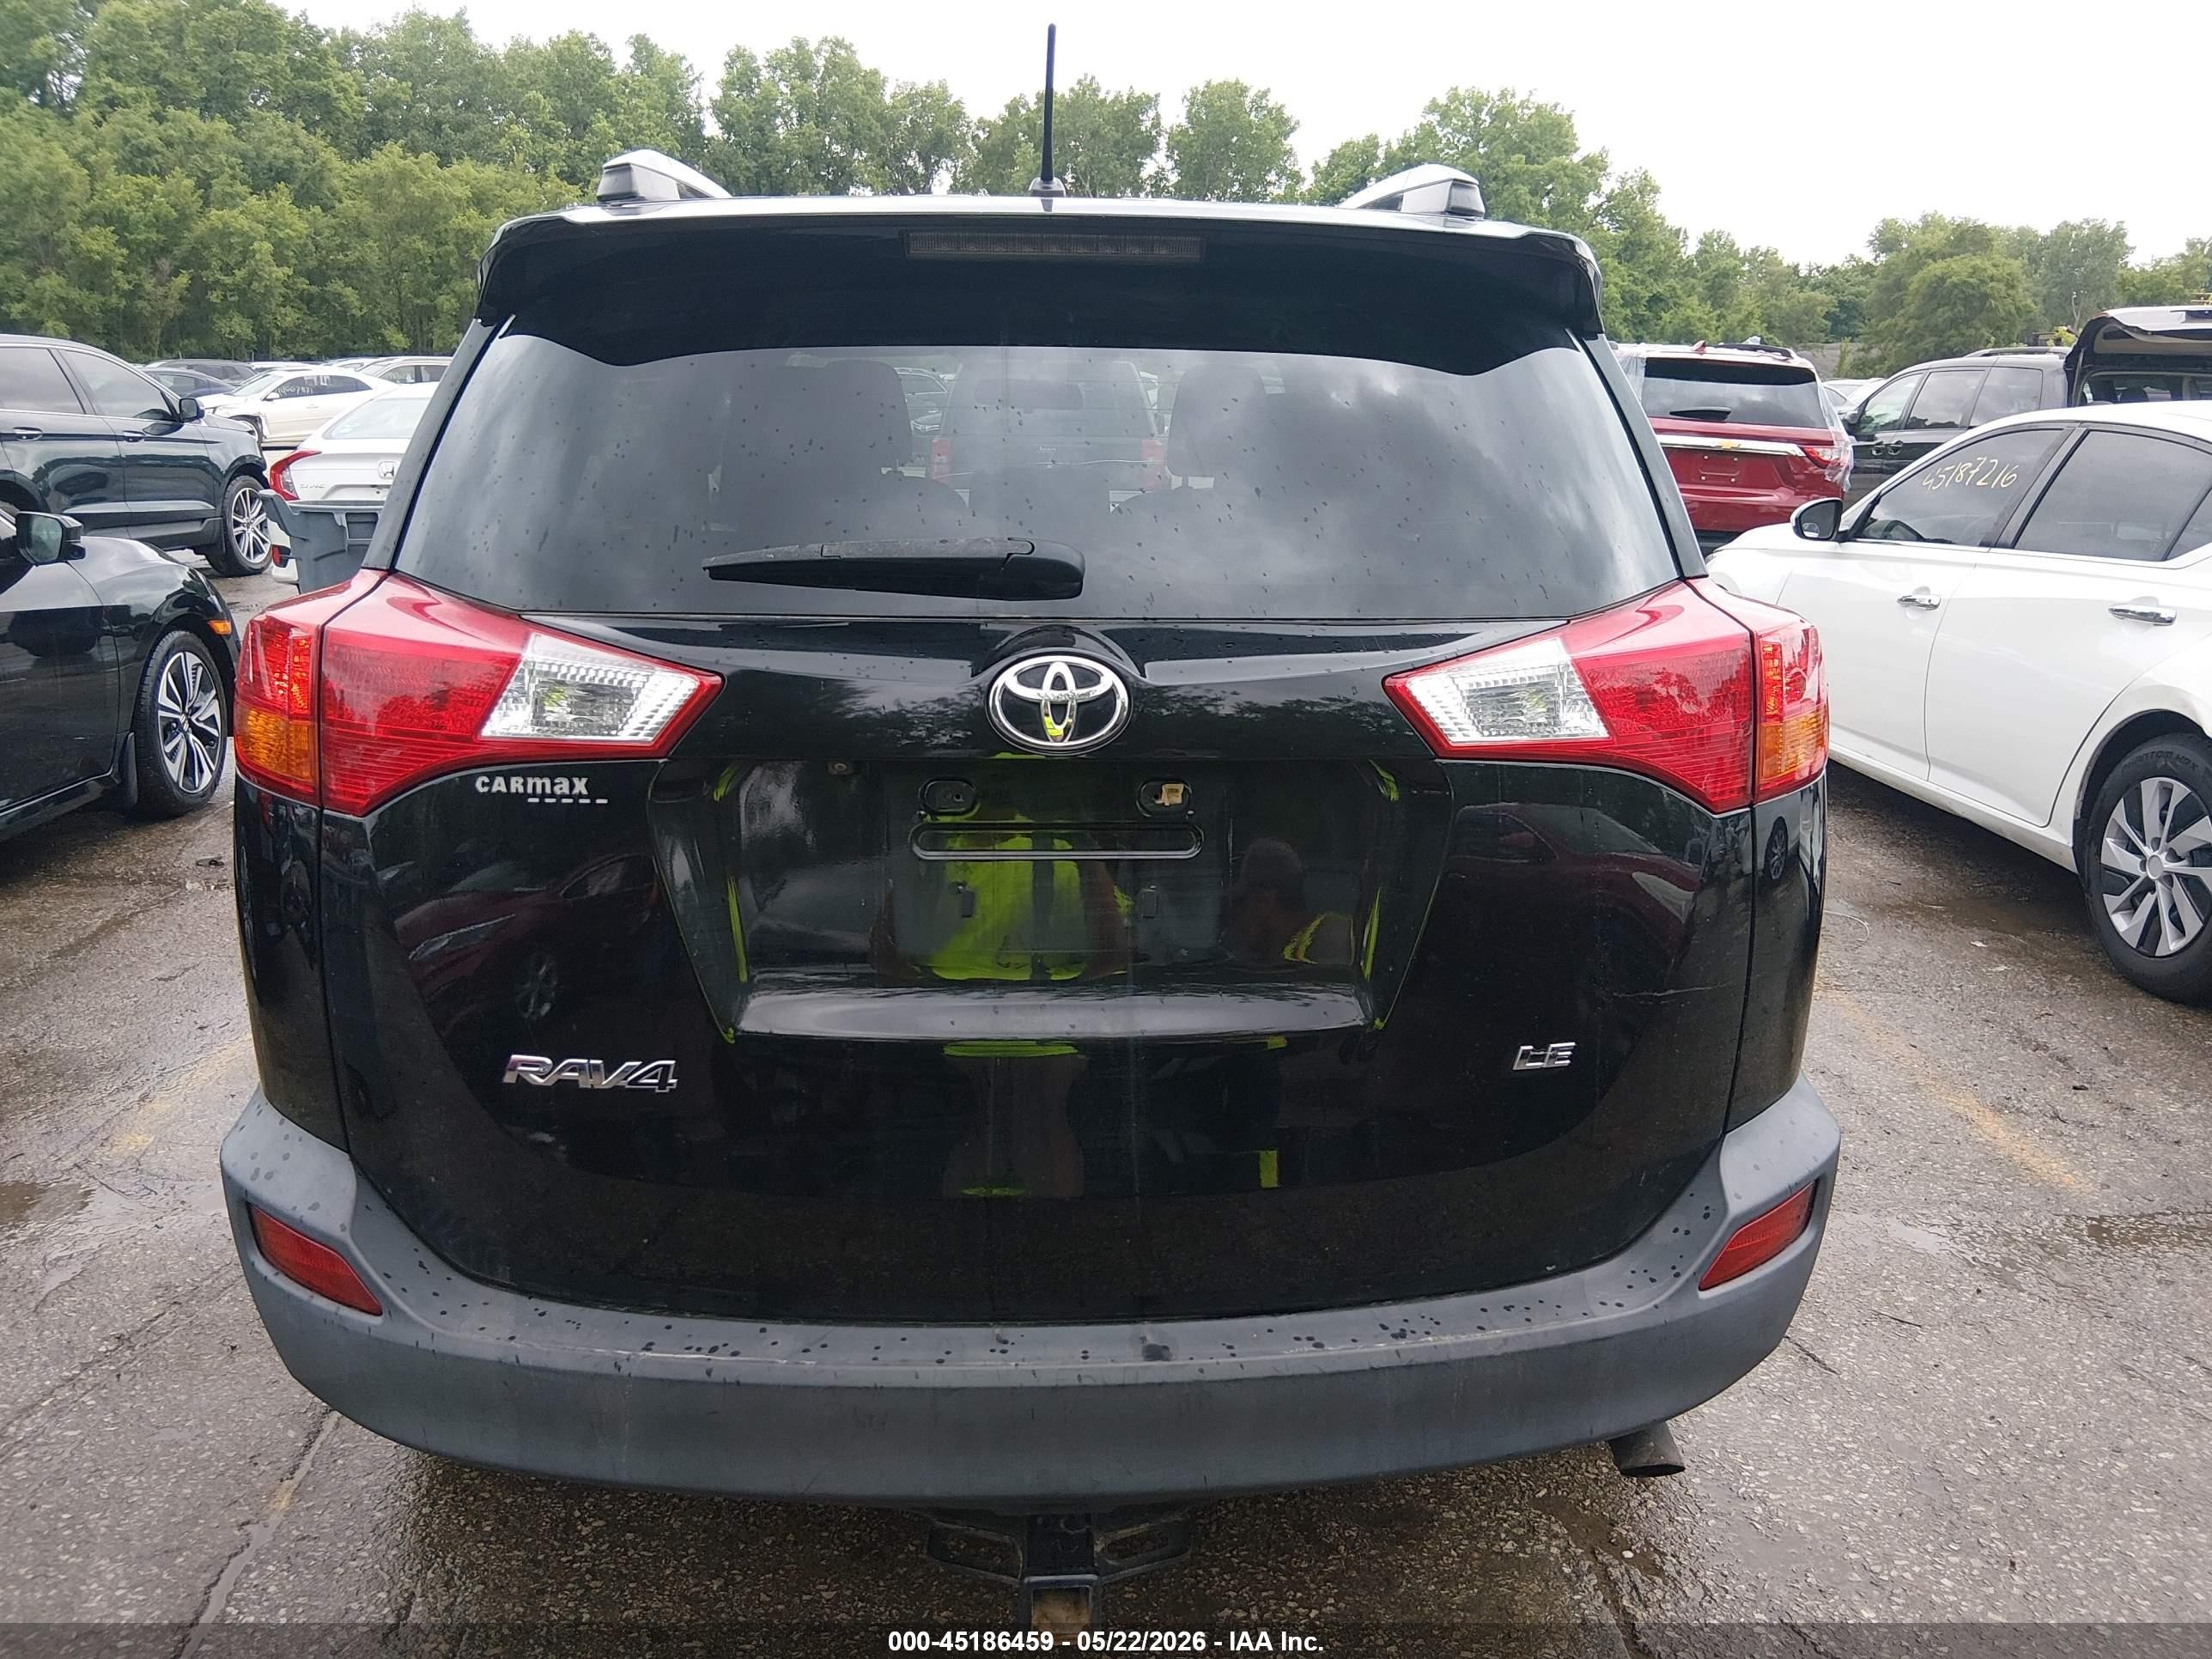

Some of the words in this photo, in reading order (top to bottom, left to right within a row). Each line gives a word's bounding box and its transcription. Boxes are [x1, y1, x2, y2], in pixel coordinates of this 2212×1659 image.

[1923, 456, 2019, 490] 45187216
[502, 1054, 678, 1092] RAV4
[1512, 1042, 1577, 1071] LE
